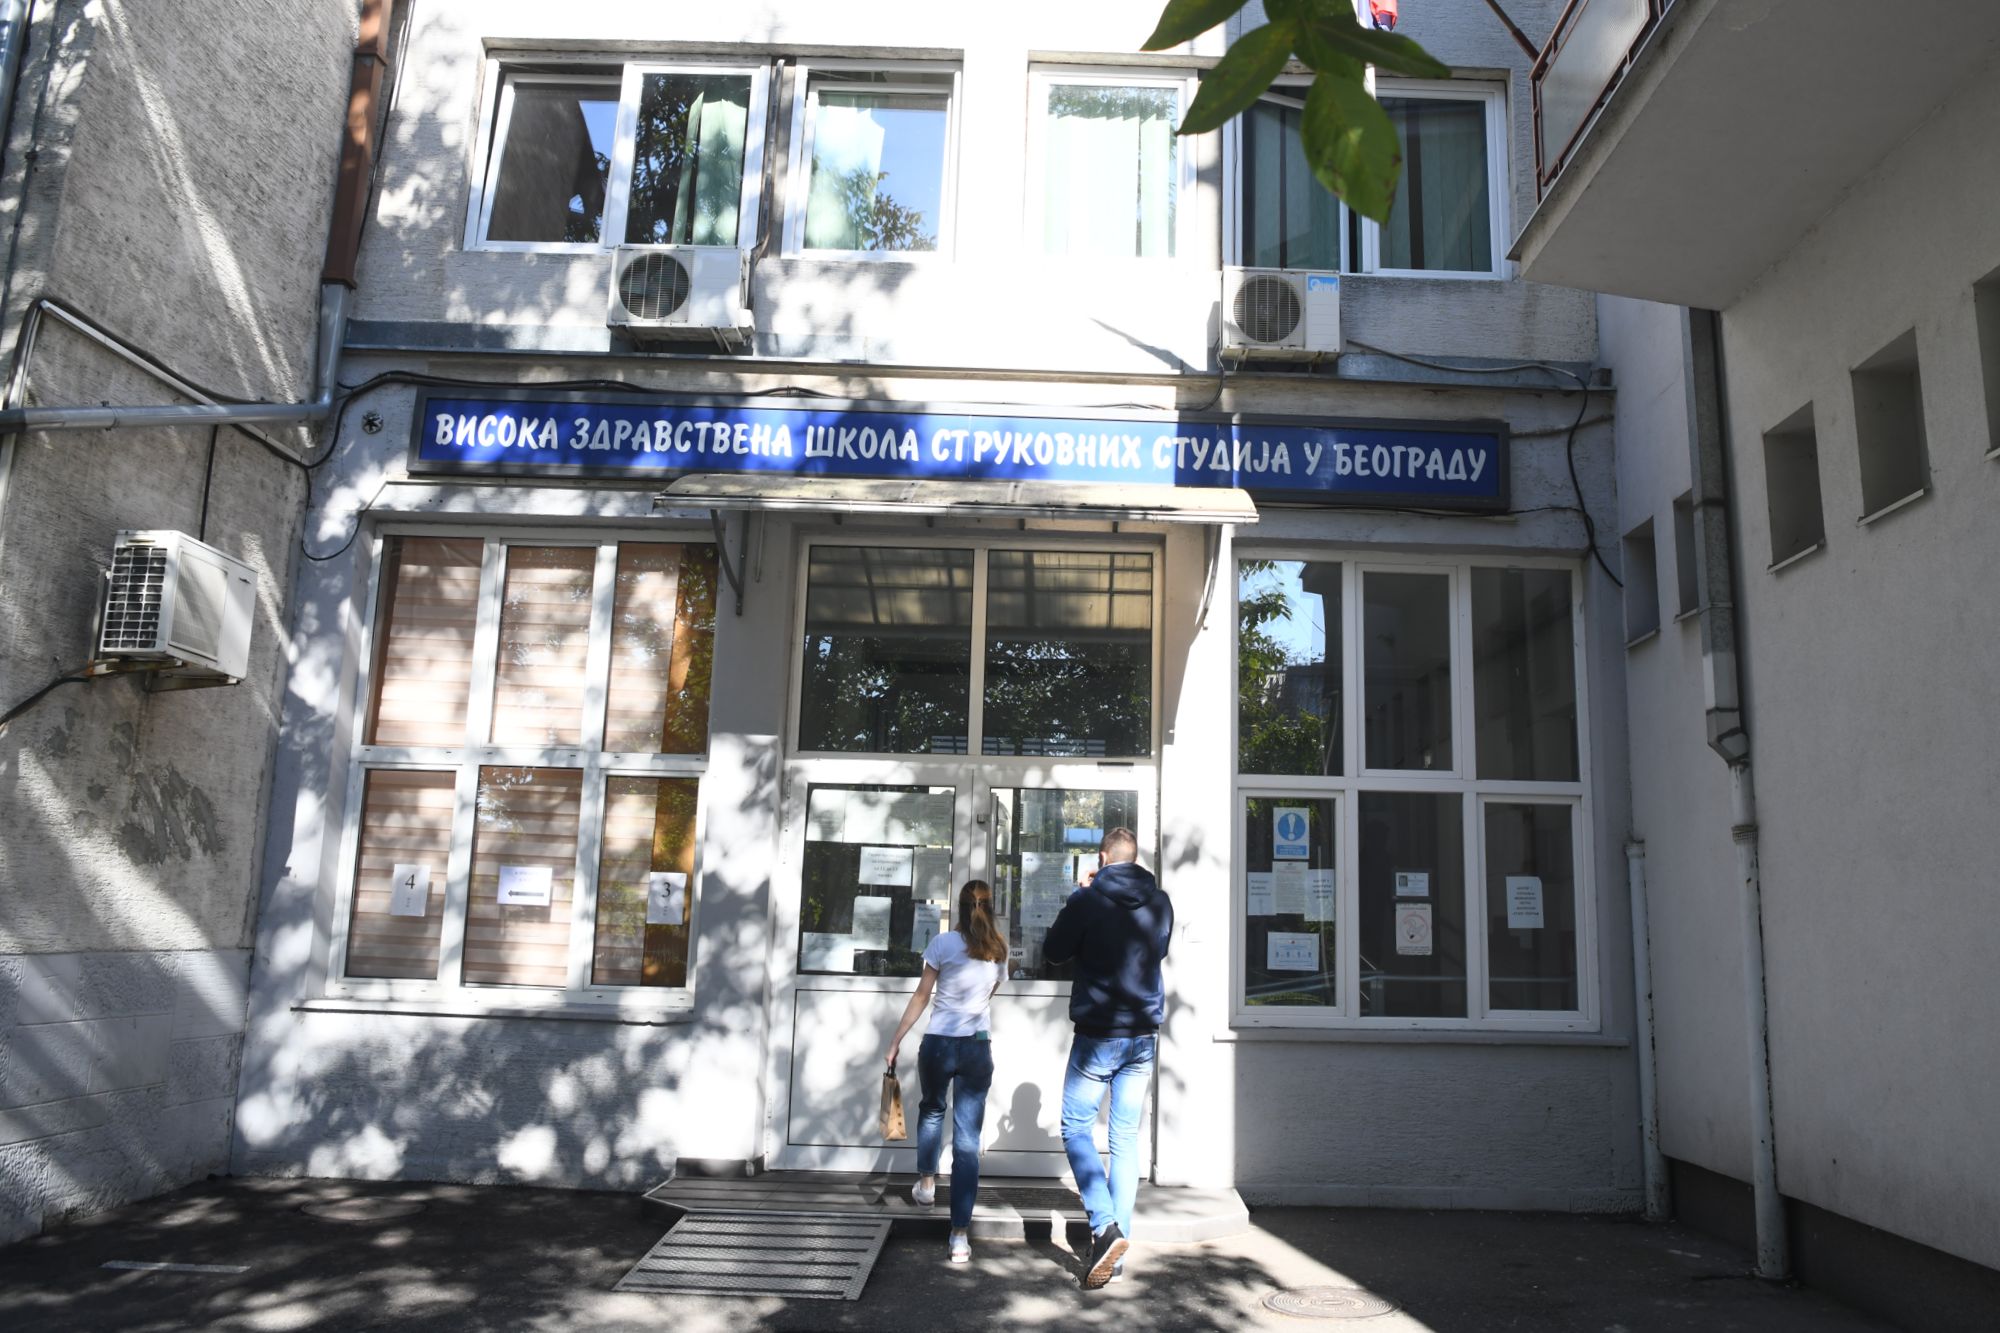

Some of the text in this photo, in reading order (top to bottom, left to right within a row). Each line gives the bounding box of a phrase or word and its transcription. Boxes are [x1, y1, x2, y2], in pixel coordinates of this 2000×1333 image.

[436, 413, 1486, 481] ВИСОКА ЗДРАВСТВЕНА ШКОЛА СТРУКОВНИХ СТУДИЈА У БЕОГРАДУ
[405, 874, 416, 889] 4
[662, 882, 671, 898] 3
